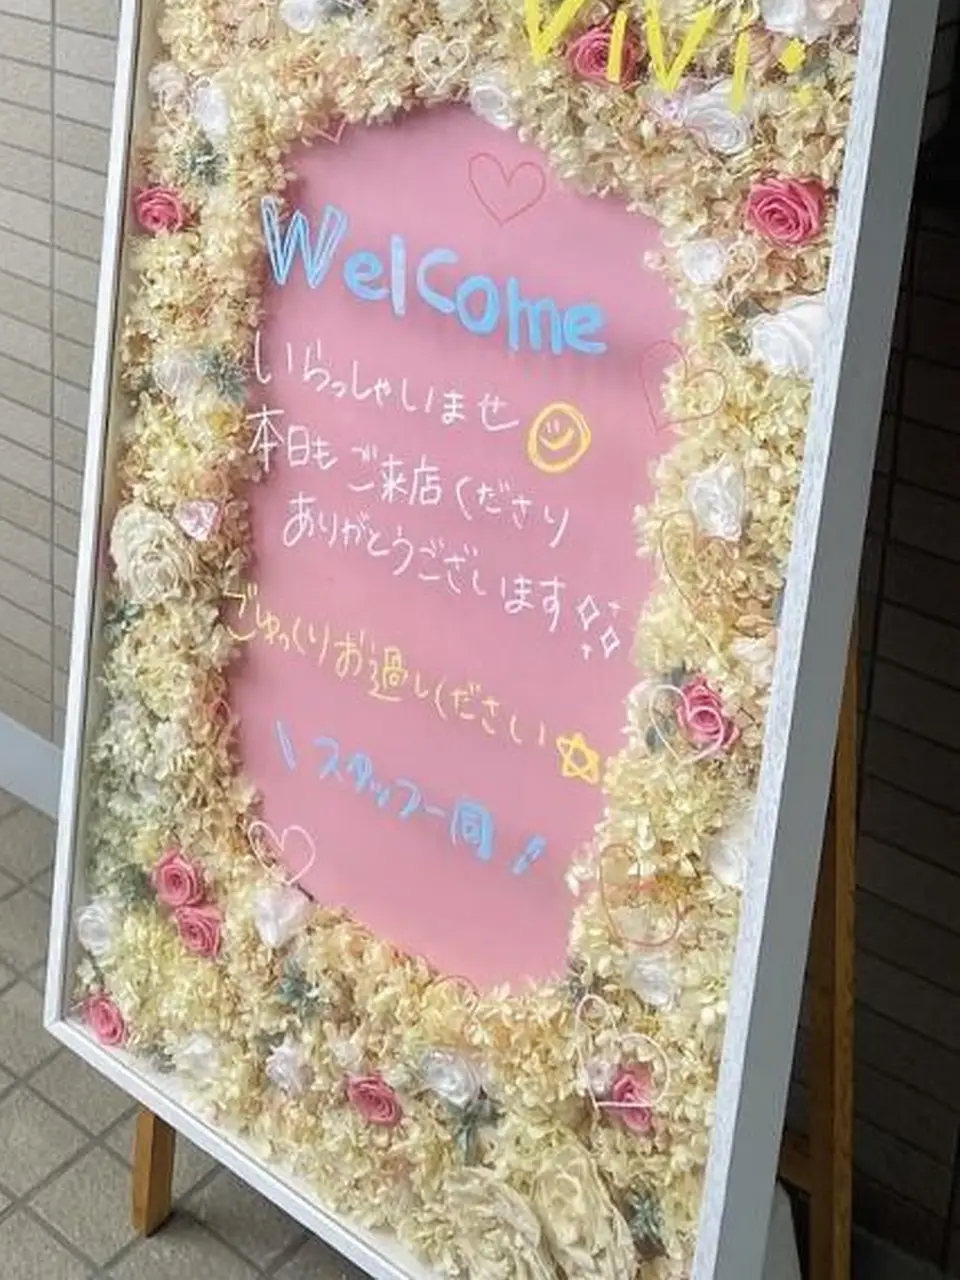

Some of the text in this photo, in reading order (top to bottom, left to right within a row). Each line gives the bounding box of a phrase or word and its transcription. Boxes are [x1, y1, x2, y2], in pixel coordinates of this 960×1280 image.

[252, 330, 520, 433] いらっしゃいませ
[282, 492, 566, 632] ありがとうございます
